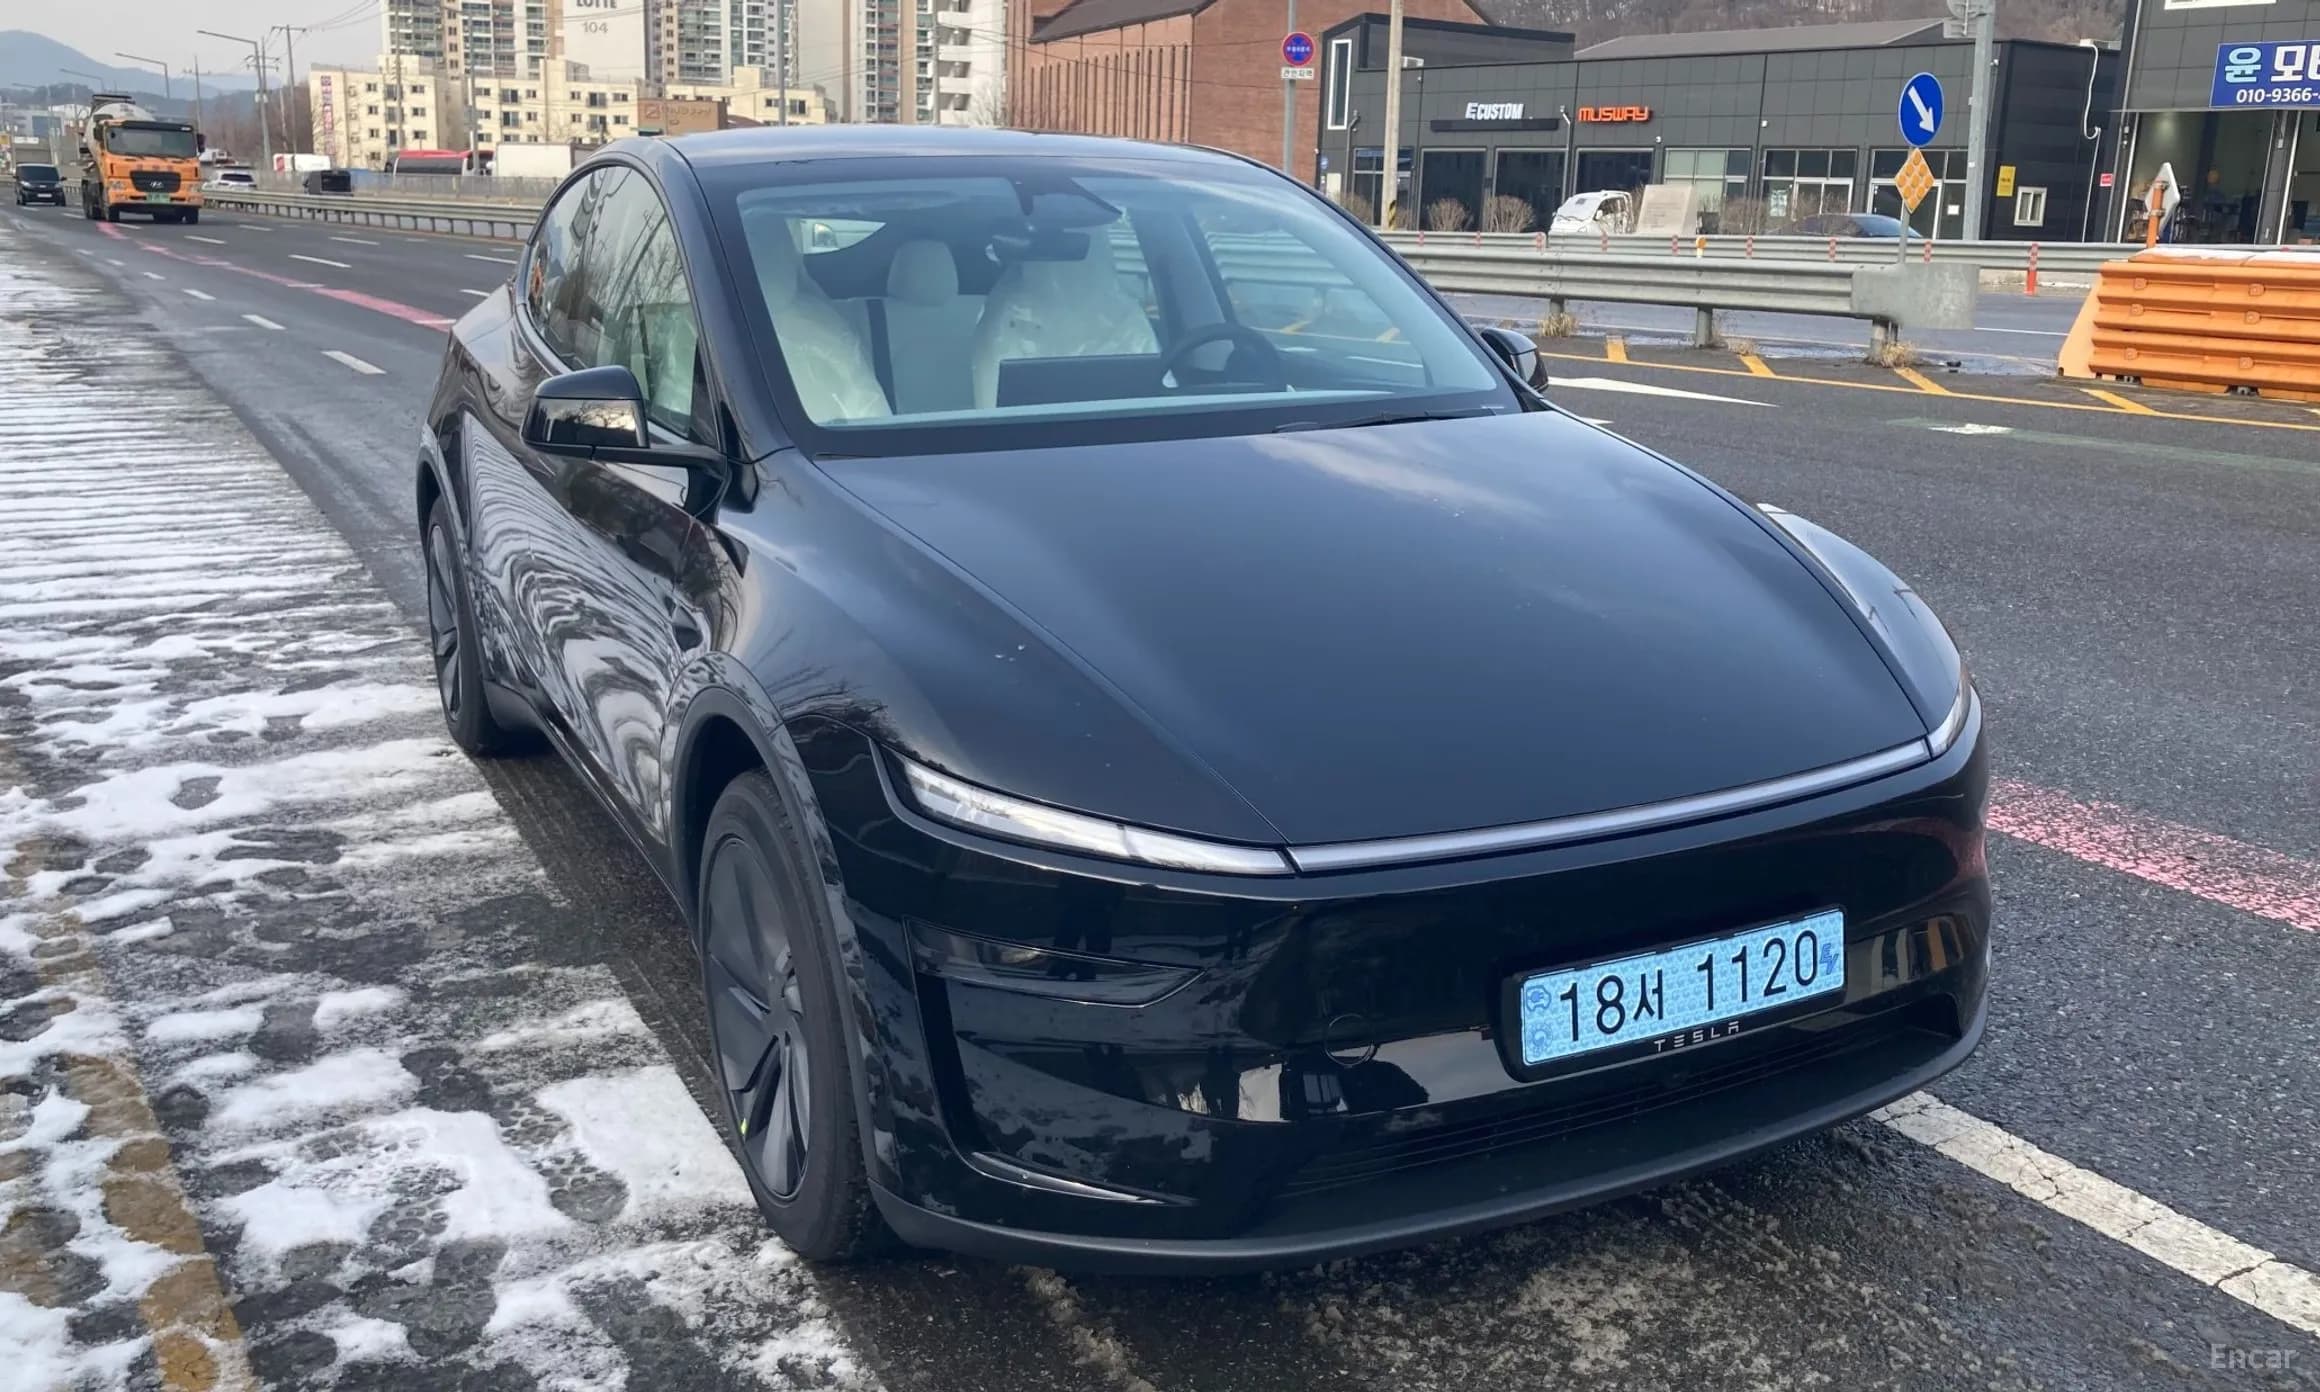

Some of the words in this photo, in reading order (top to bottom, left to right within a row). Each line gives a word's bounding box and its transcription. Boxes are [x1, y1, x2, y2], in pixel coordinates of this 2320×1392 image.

[582, 21, 608, 33] 104
[2225, 47, 2261, 83] 윤
[2236, 87, 2320, 103] 010-9366-
[1578, 106, 1649, 122] MUSWAY
[1559, 968, 1664, 1042] 18서
[1696, 929, 1819, 1012] 1120
[1654, 1020, 1741, 1052] TESLA
